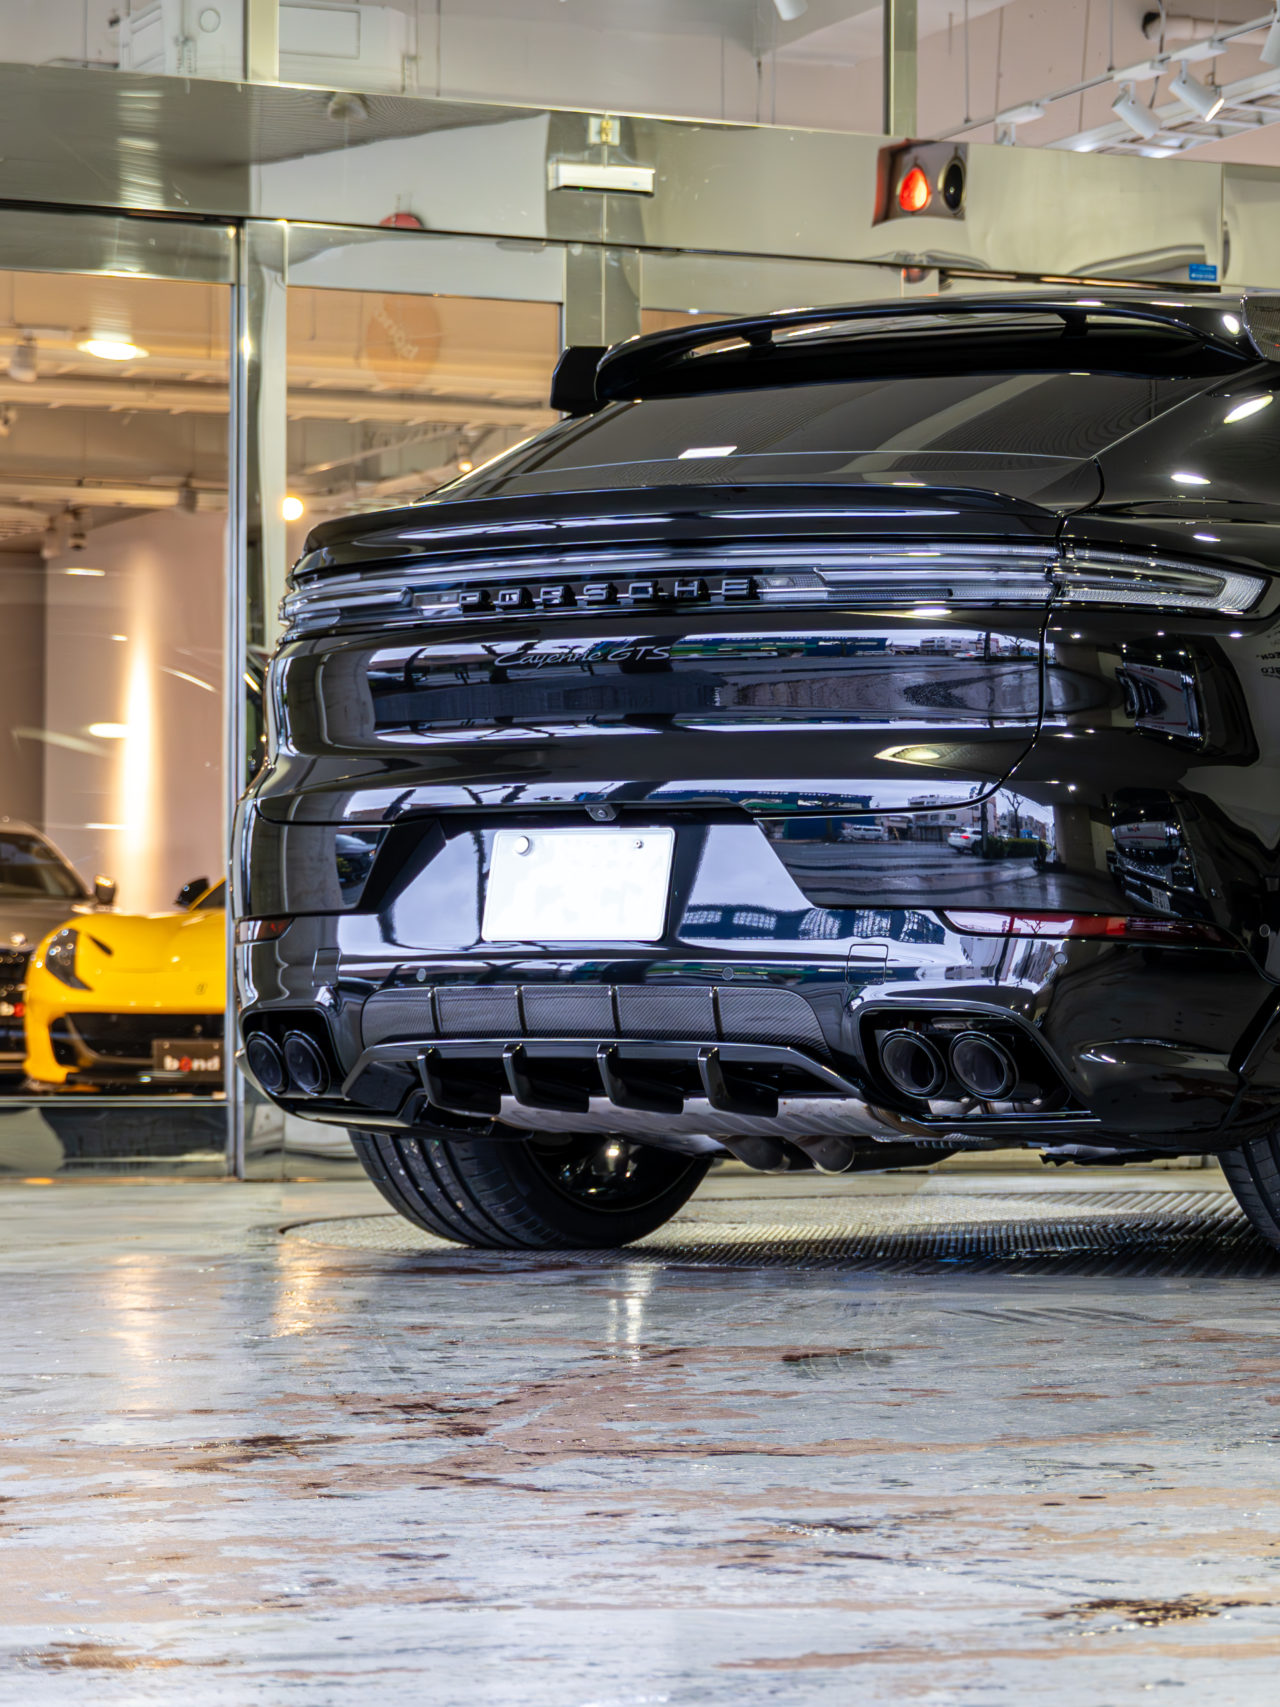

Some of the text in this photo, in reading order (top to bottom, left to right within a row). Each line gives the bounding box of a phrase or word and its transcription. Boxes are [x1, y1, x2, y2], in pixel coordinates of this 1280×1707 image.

[458, 579, 750, 606] PORSCHE
[494, 646, 672, 669] Cayenne GTS
[164, 1055, 220, 1072] bond
